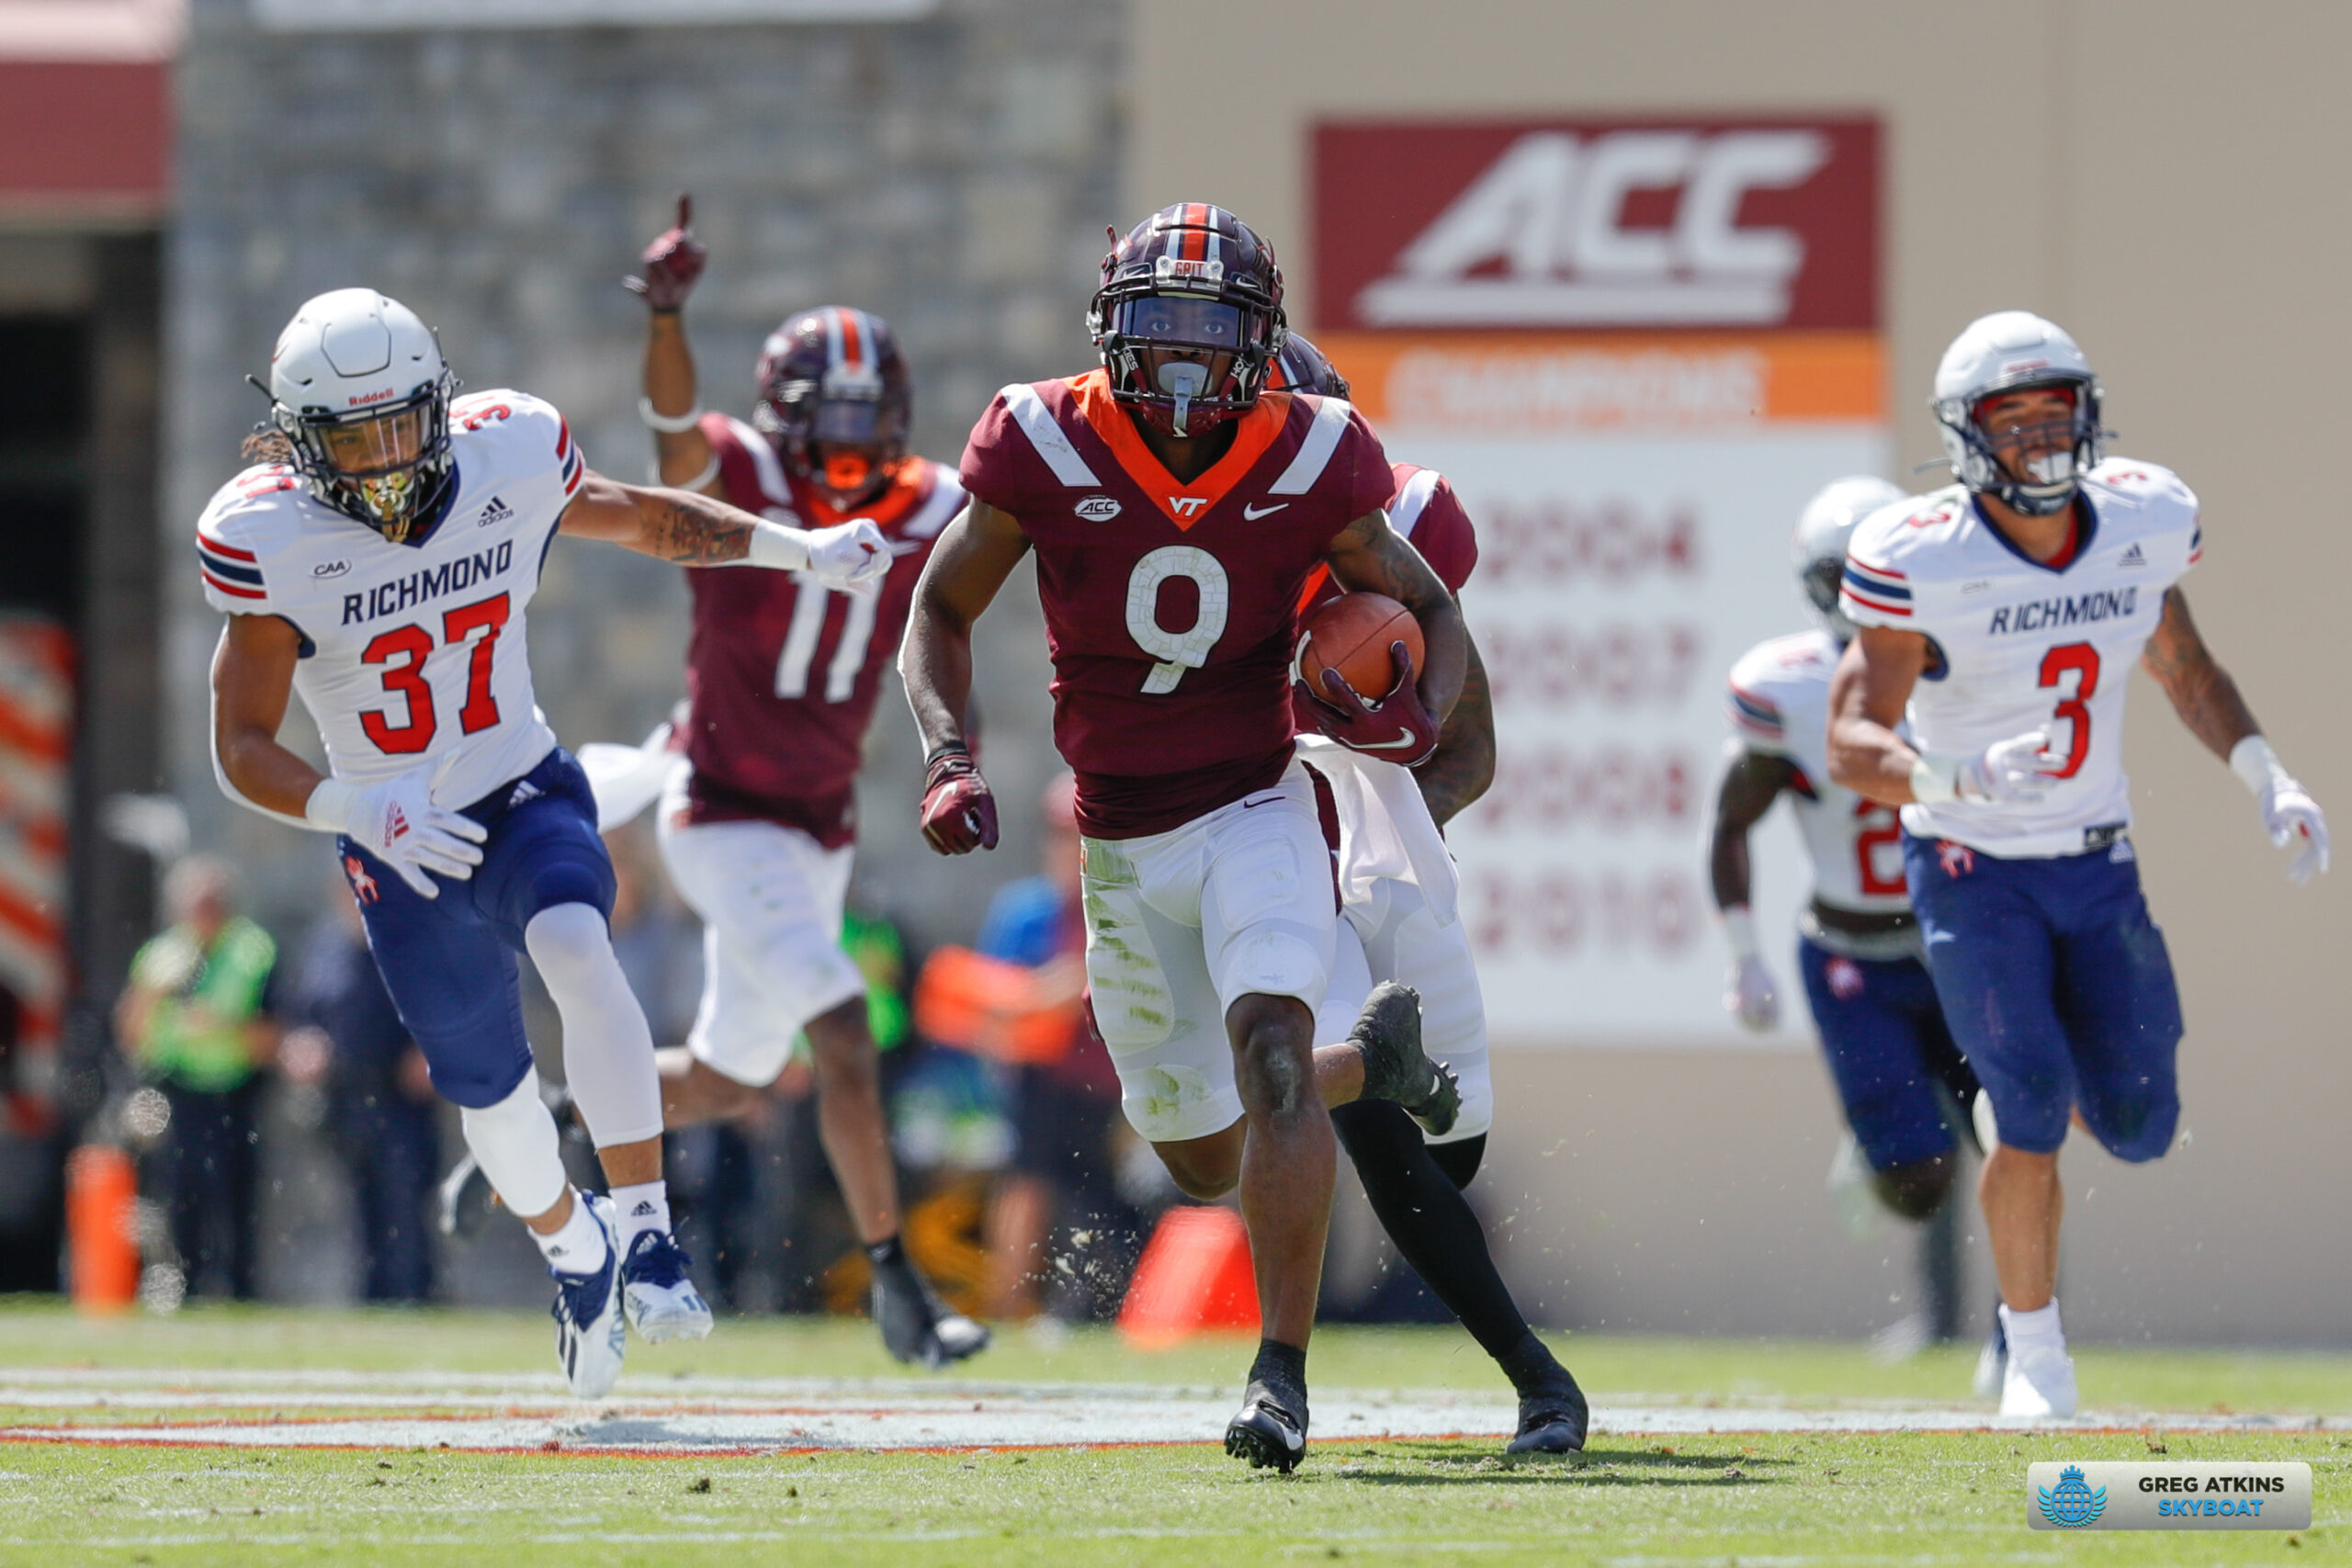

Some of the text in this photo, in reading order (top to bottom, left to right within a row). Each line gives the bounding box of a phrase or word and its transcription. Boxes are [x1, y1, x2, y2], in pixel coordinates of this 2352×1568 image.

[1401, 132, 1826, 279] ACC
[1175, 261, 1204, 276] GRIT
[348, 389, 394, 406] Riddell
[477, 510, 514, 528] adidas
[1168, 496, 1209, 517] VT
[314, 559, 345, 576] CAA
[341, 538, 514, 626] RICHMOND
[774, 568, 886, 705] 11
[1125, 544, 1229, 694] 9
[1988, 585, 2138, 636] RICHMOND
[358, 590, 511, 756] 37
[2036, 639, 2100, 780] 3
